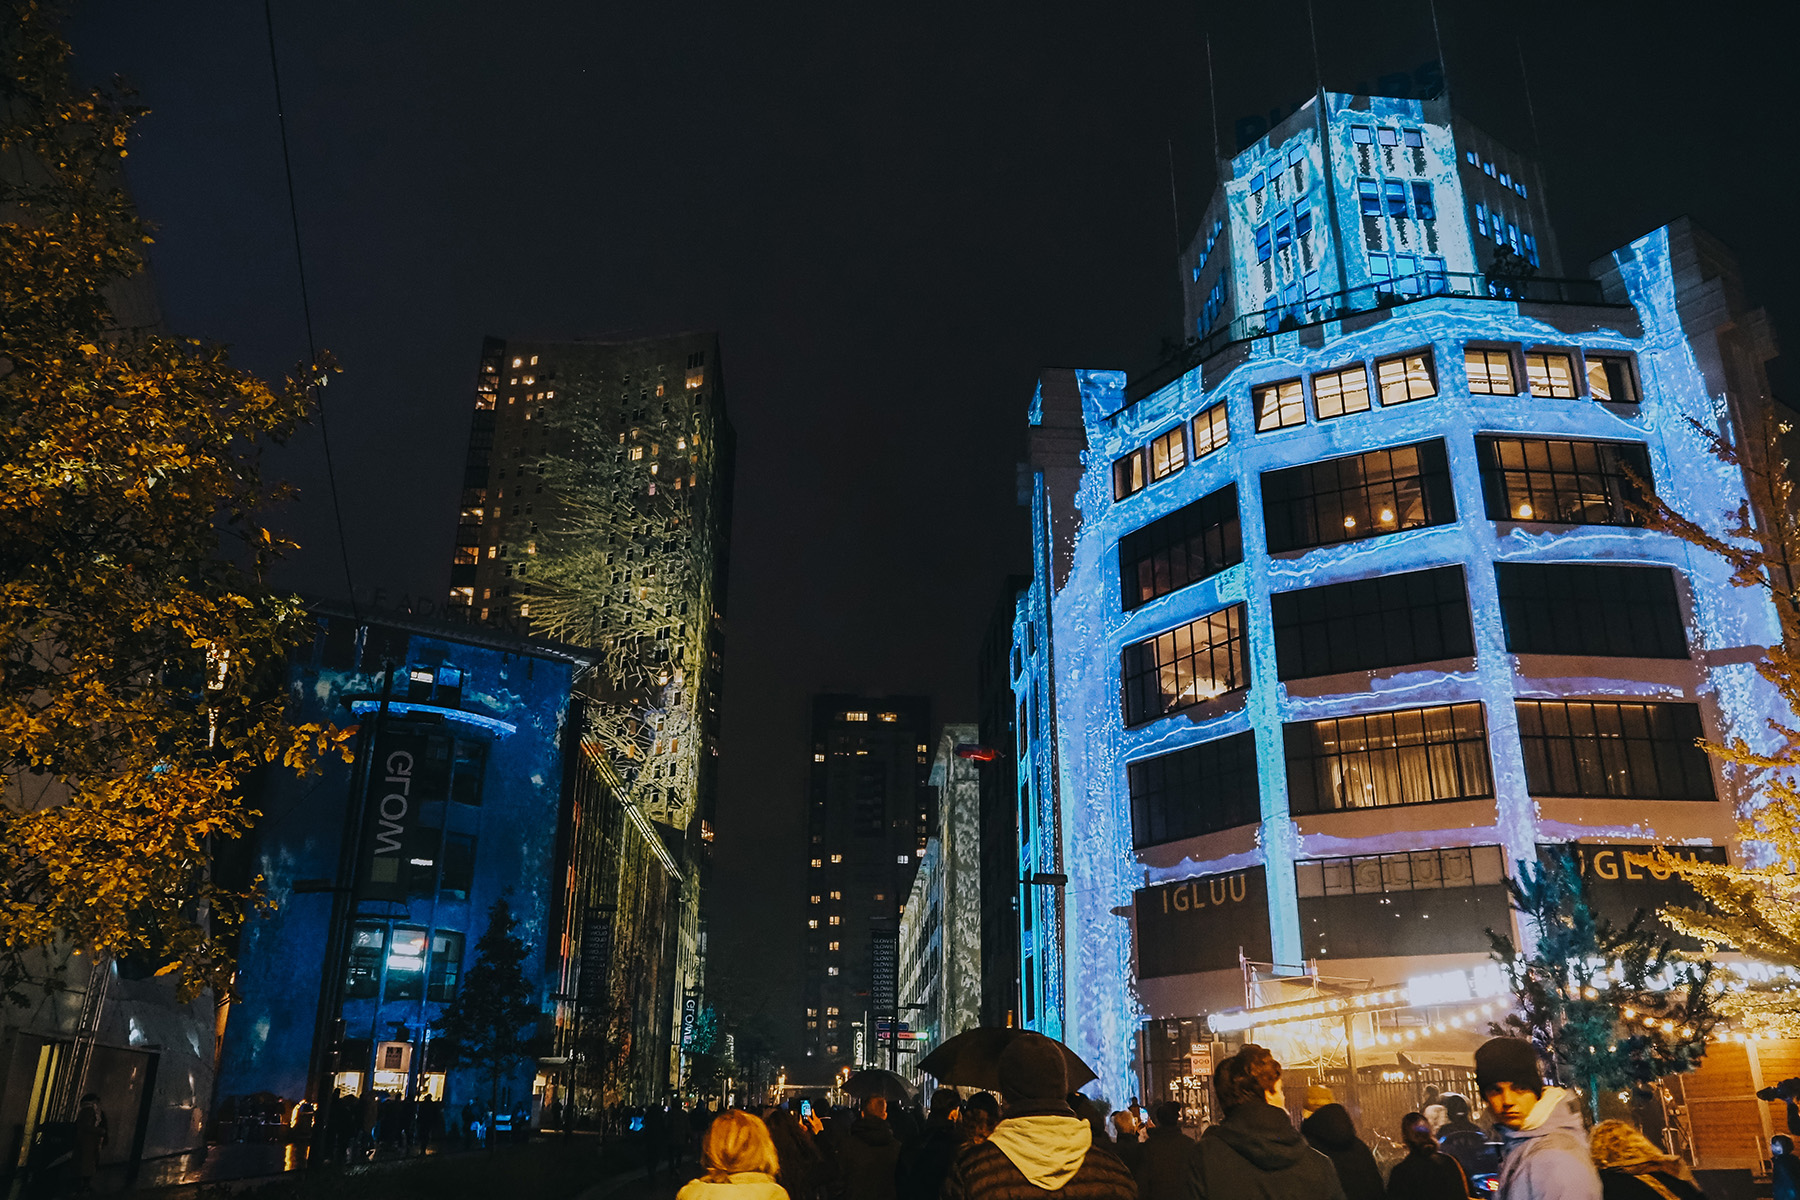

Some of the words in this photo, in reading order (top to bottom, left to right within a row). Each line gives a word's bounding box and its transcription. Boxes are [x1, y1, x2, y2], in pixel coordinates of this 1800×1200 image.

[374, 750, 414, 855] GLOW
[1337, 852, 1471, 888] IGLUU
[1162, 873, 1246, 914] IGLUU
